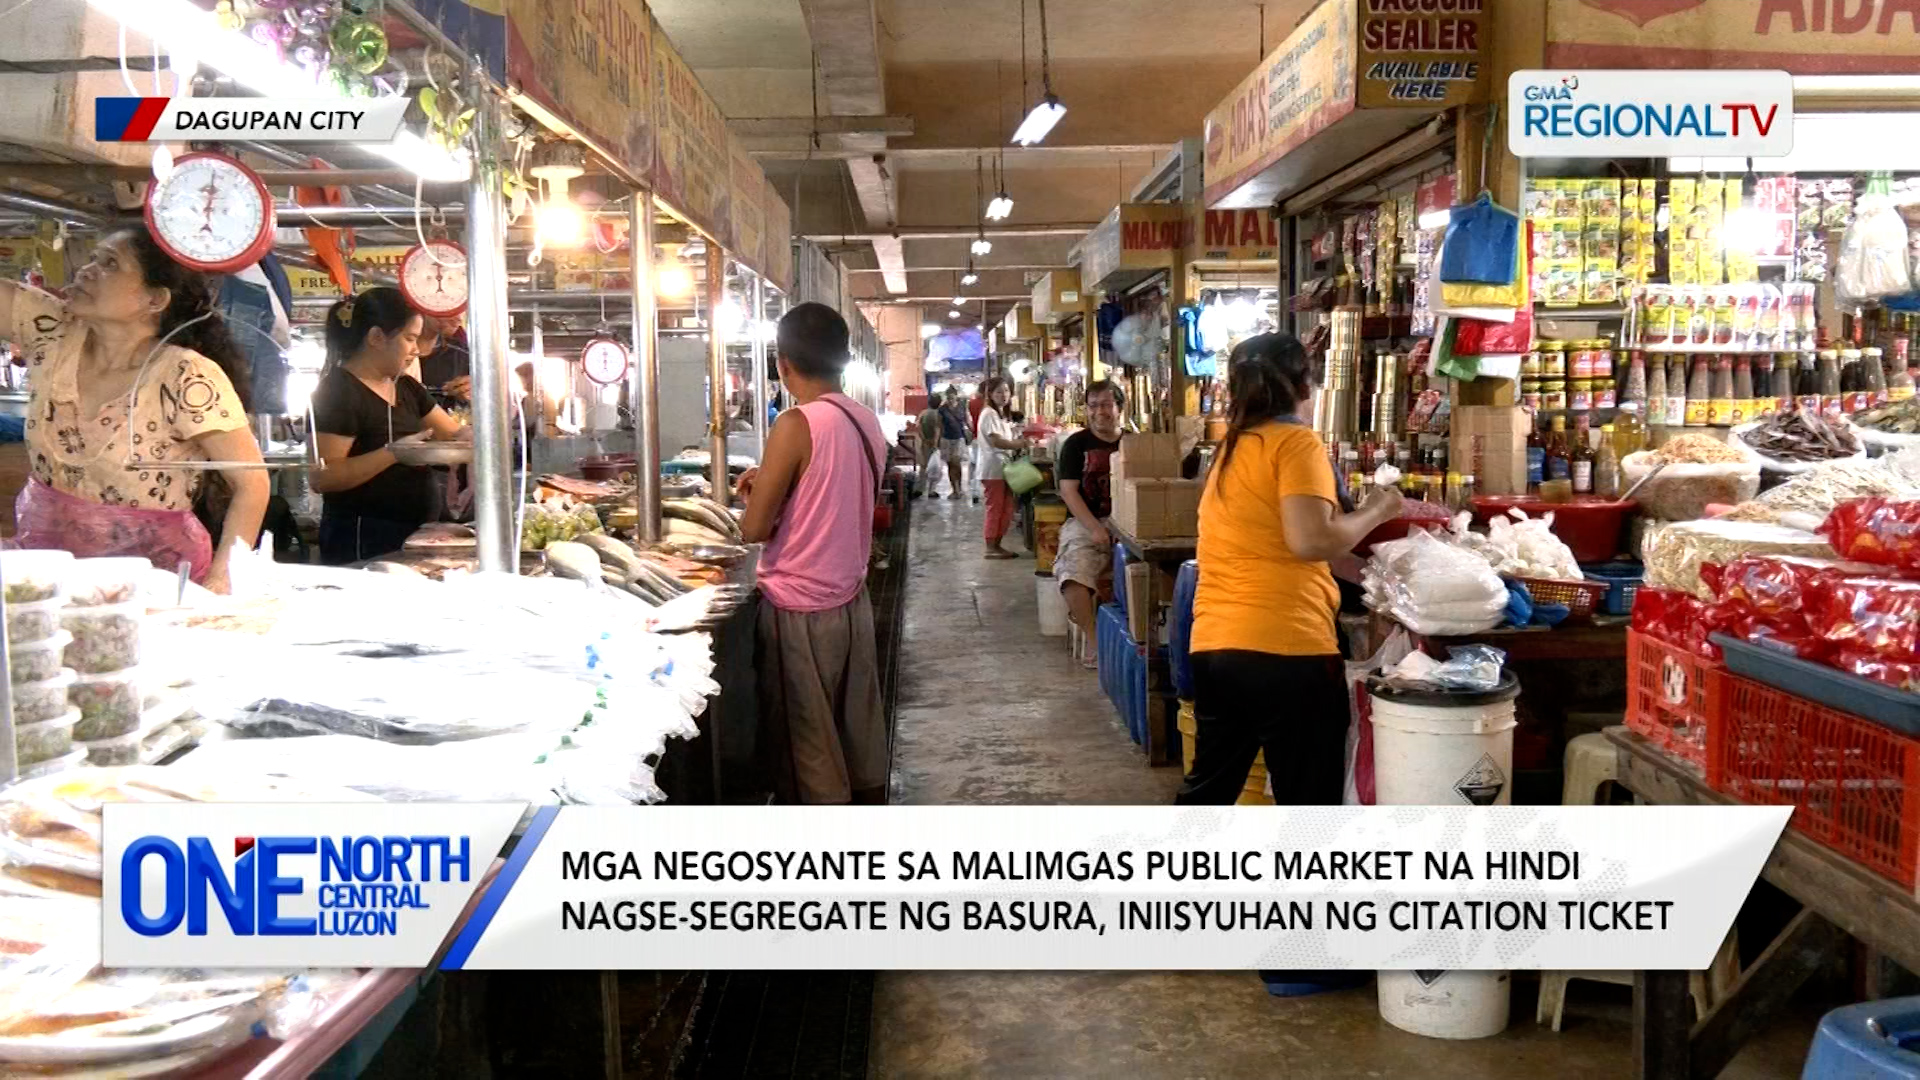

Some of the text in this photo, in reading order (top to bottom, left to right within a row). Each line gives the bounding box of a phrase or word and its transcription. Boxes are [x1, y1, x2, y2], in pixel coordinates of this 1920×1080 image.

[1363, 19, 1479, 53] SEALER
[1365, 61, 1480, 82] AVAILABLE
[1388, 82, 1448, 100] HERE
[1228, 76, 1267, 164] AIDA'S
